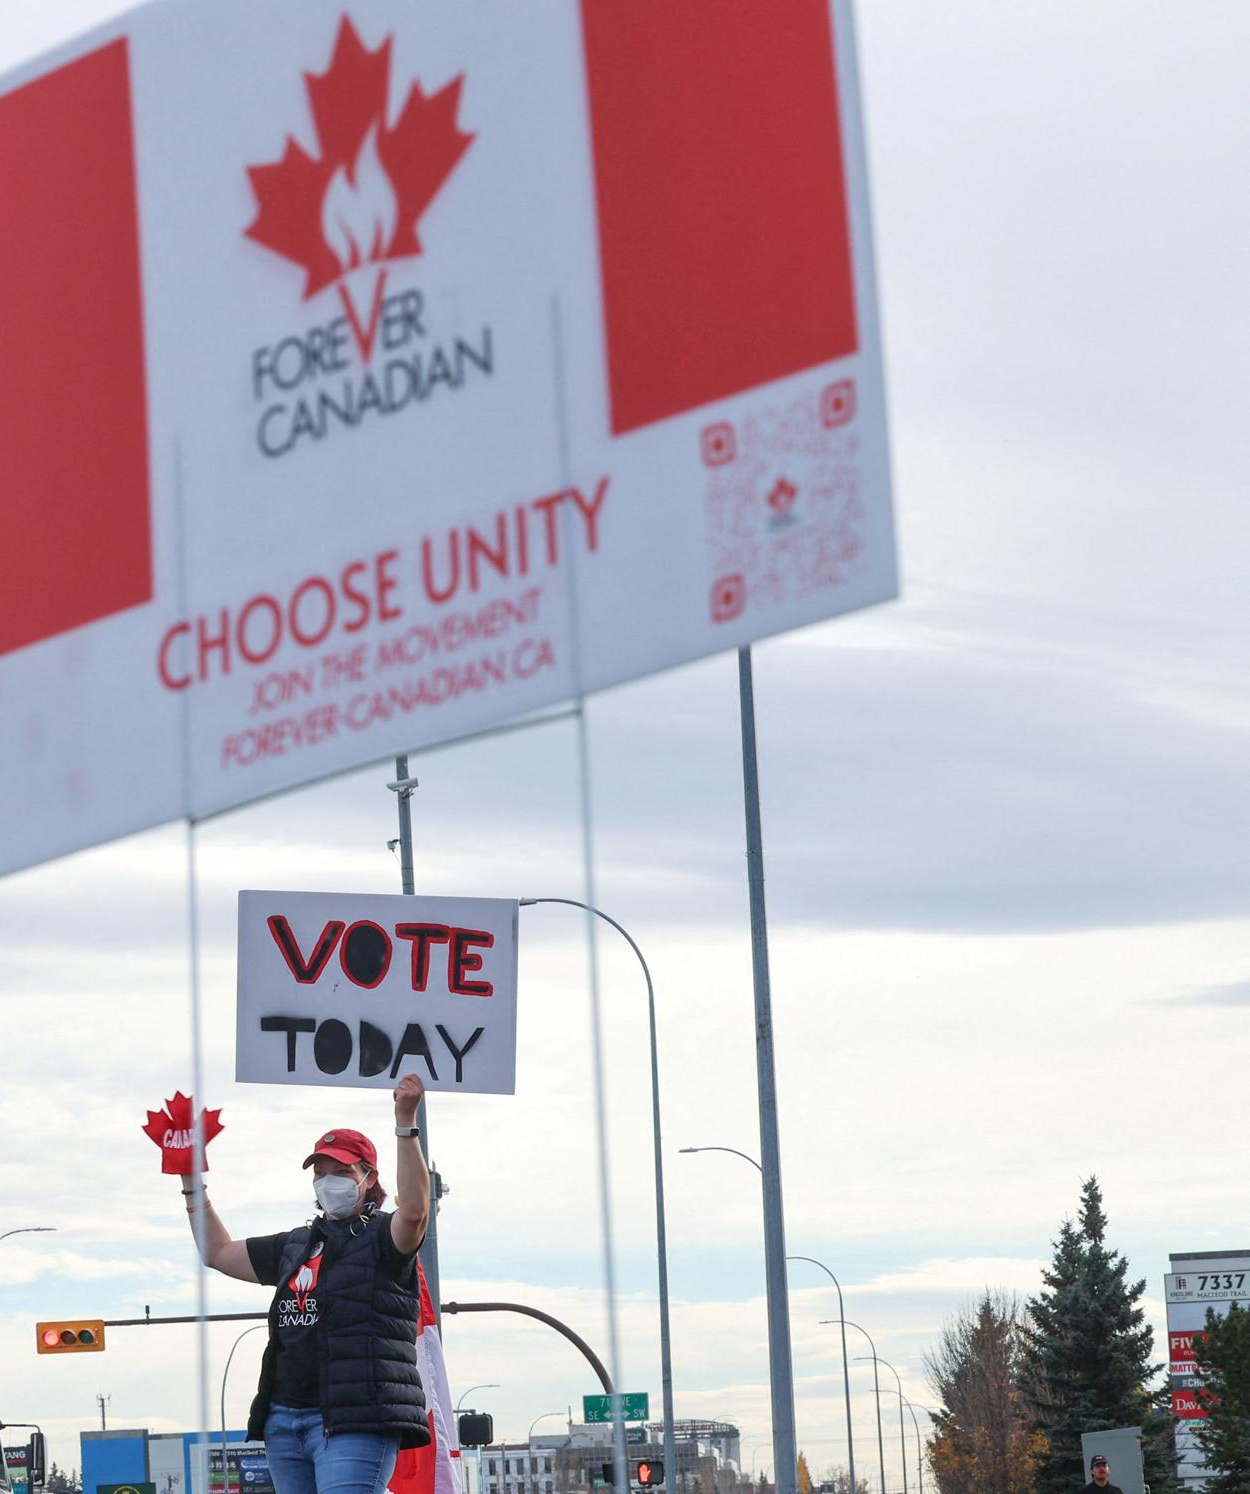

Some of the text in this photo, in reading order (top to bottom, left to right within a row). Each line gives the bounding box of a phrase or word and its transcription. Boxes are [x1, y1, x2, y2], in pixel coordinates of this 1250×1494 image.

[252, 266, 428, 400] FOREVER
[256, 322, 495, 459] CANADIAN
[157, 474, 612, 692] CHOOSE UNITY
[250, 586, 544, 716] JOIN THE MOVEMENT
[266, 914, 495, 997] VOTE
[260, 1015, 486, 1083] TODAY
[278, 1292, 318, 1313] OREVER
[1197, 1273, 1246, 1291] 7337
[588, 1408, 646, 1421] SE SW
